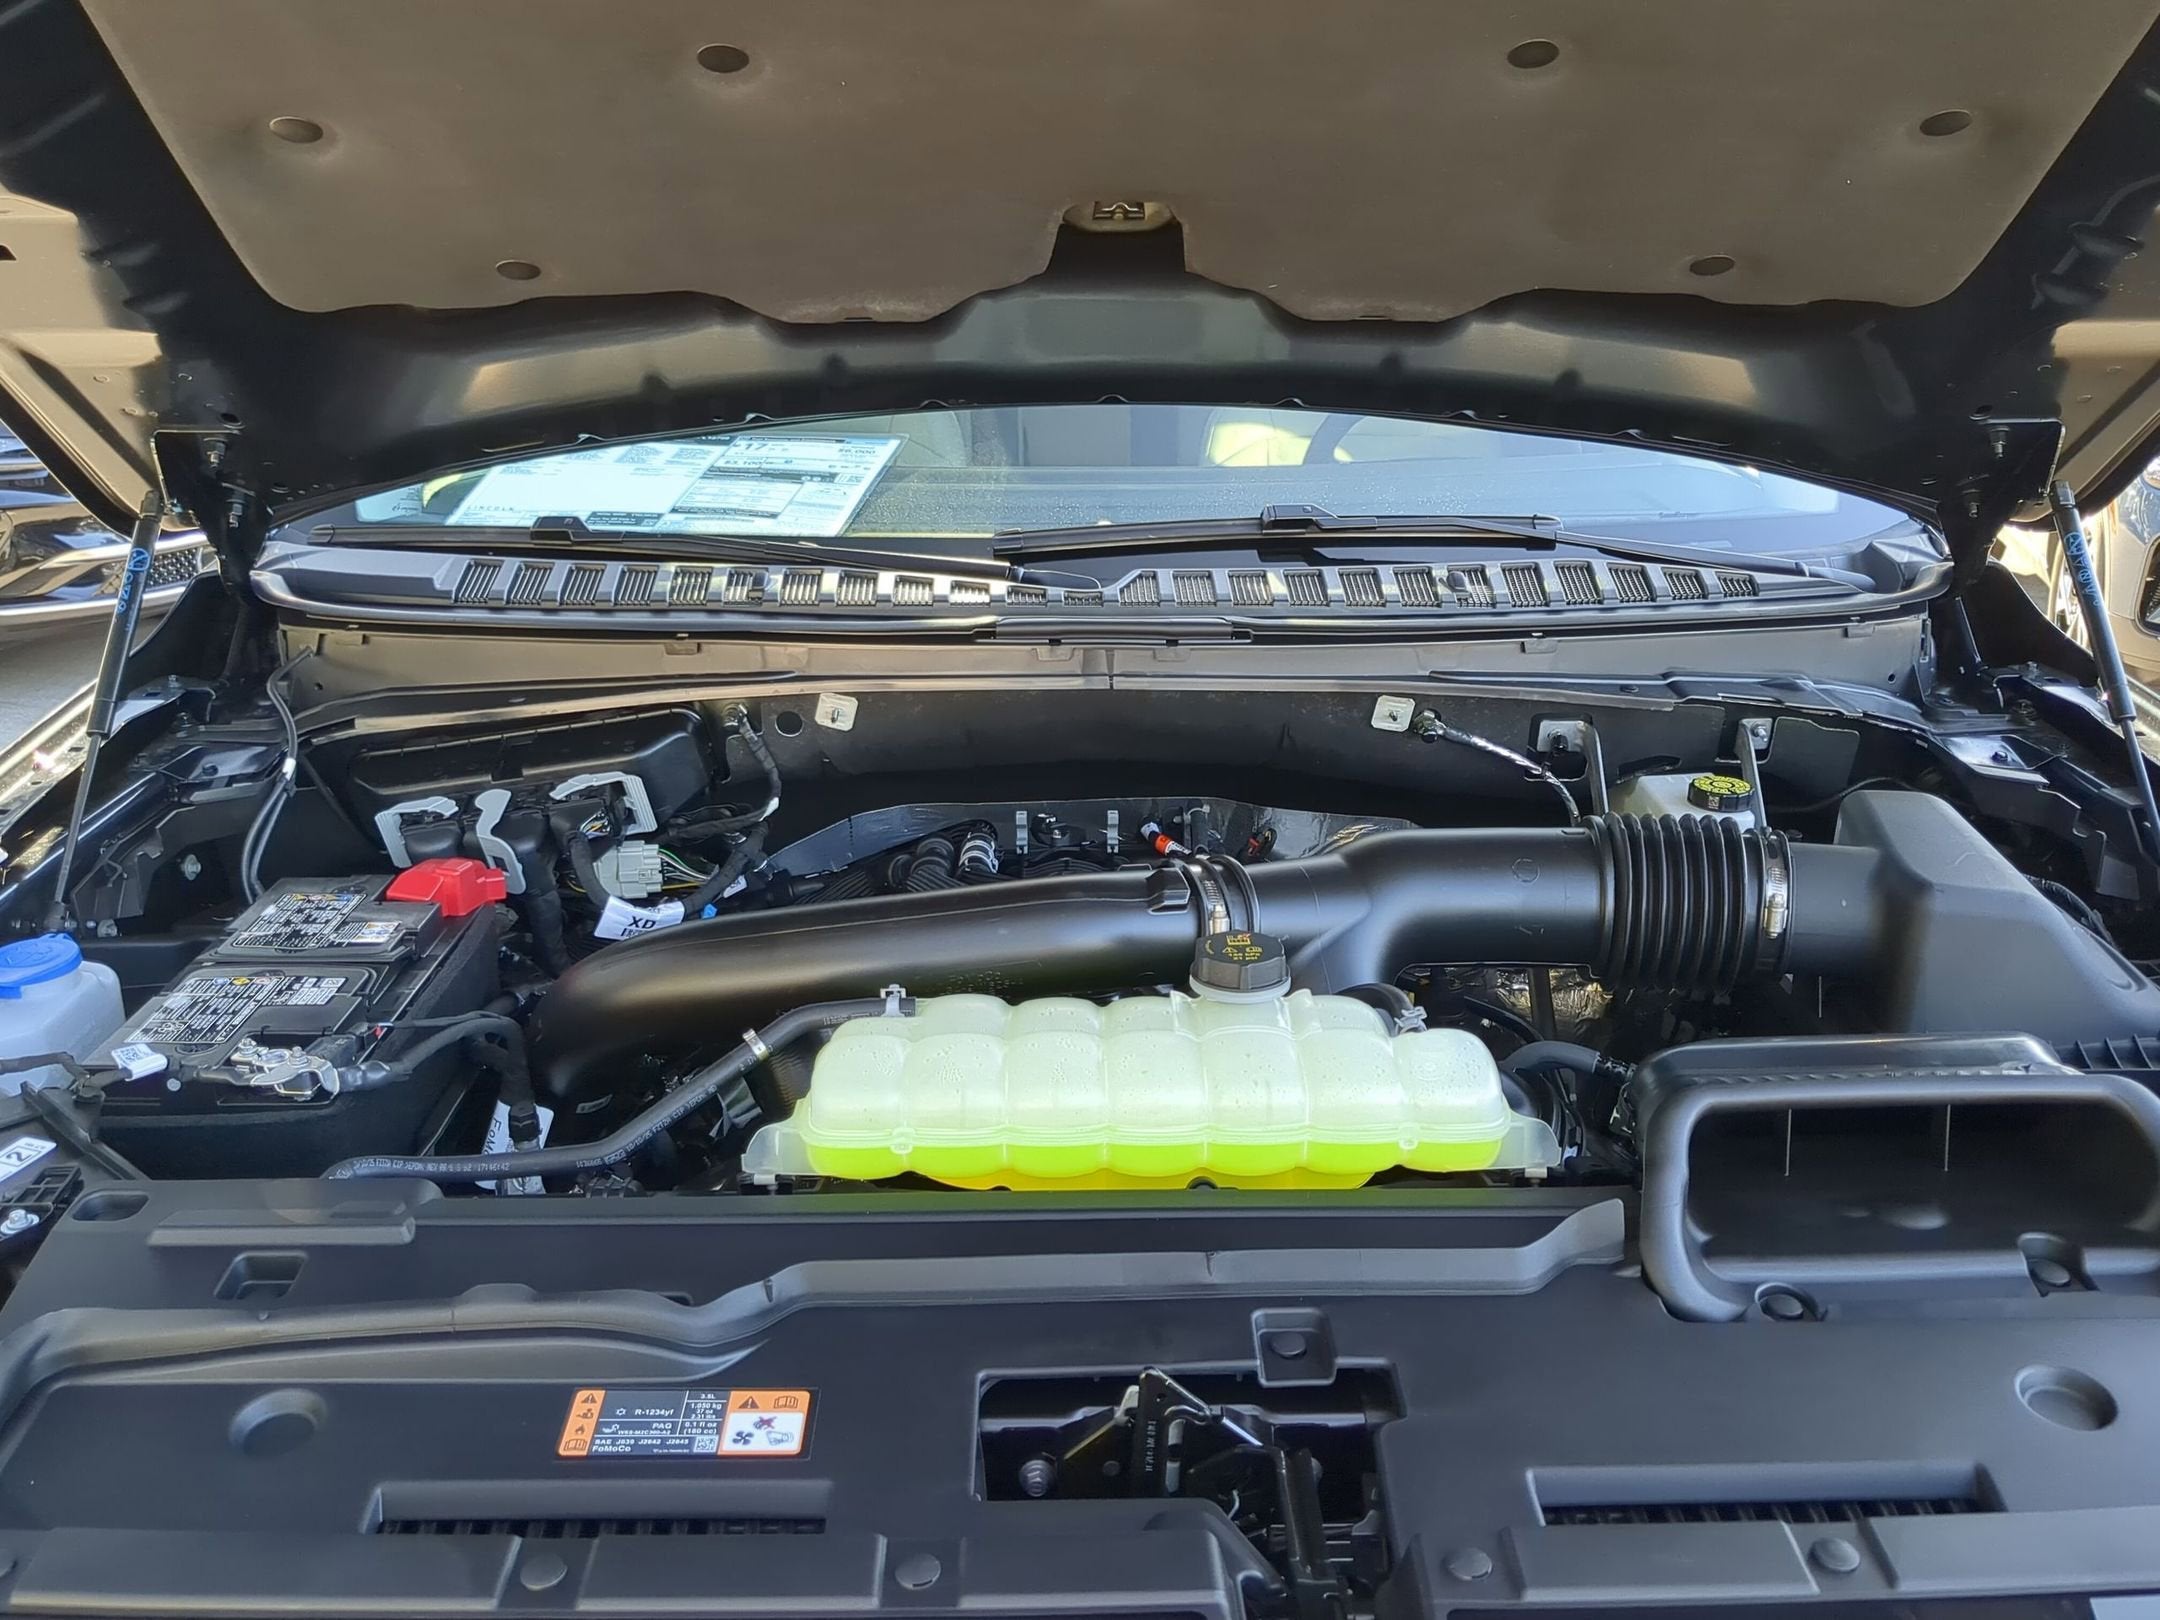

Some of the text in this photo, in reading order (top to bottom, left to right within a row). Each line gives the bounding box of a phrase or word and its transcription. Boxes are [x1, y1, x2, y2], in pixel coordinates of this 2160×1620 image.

[627, 915, 657, 930] XD
[484, 1117, 502, 1155] FoMo
[591, 1445, 632, 1453] FoMoCo
